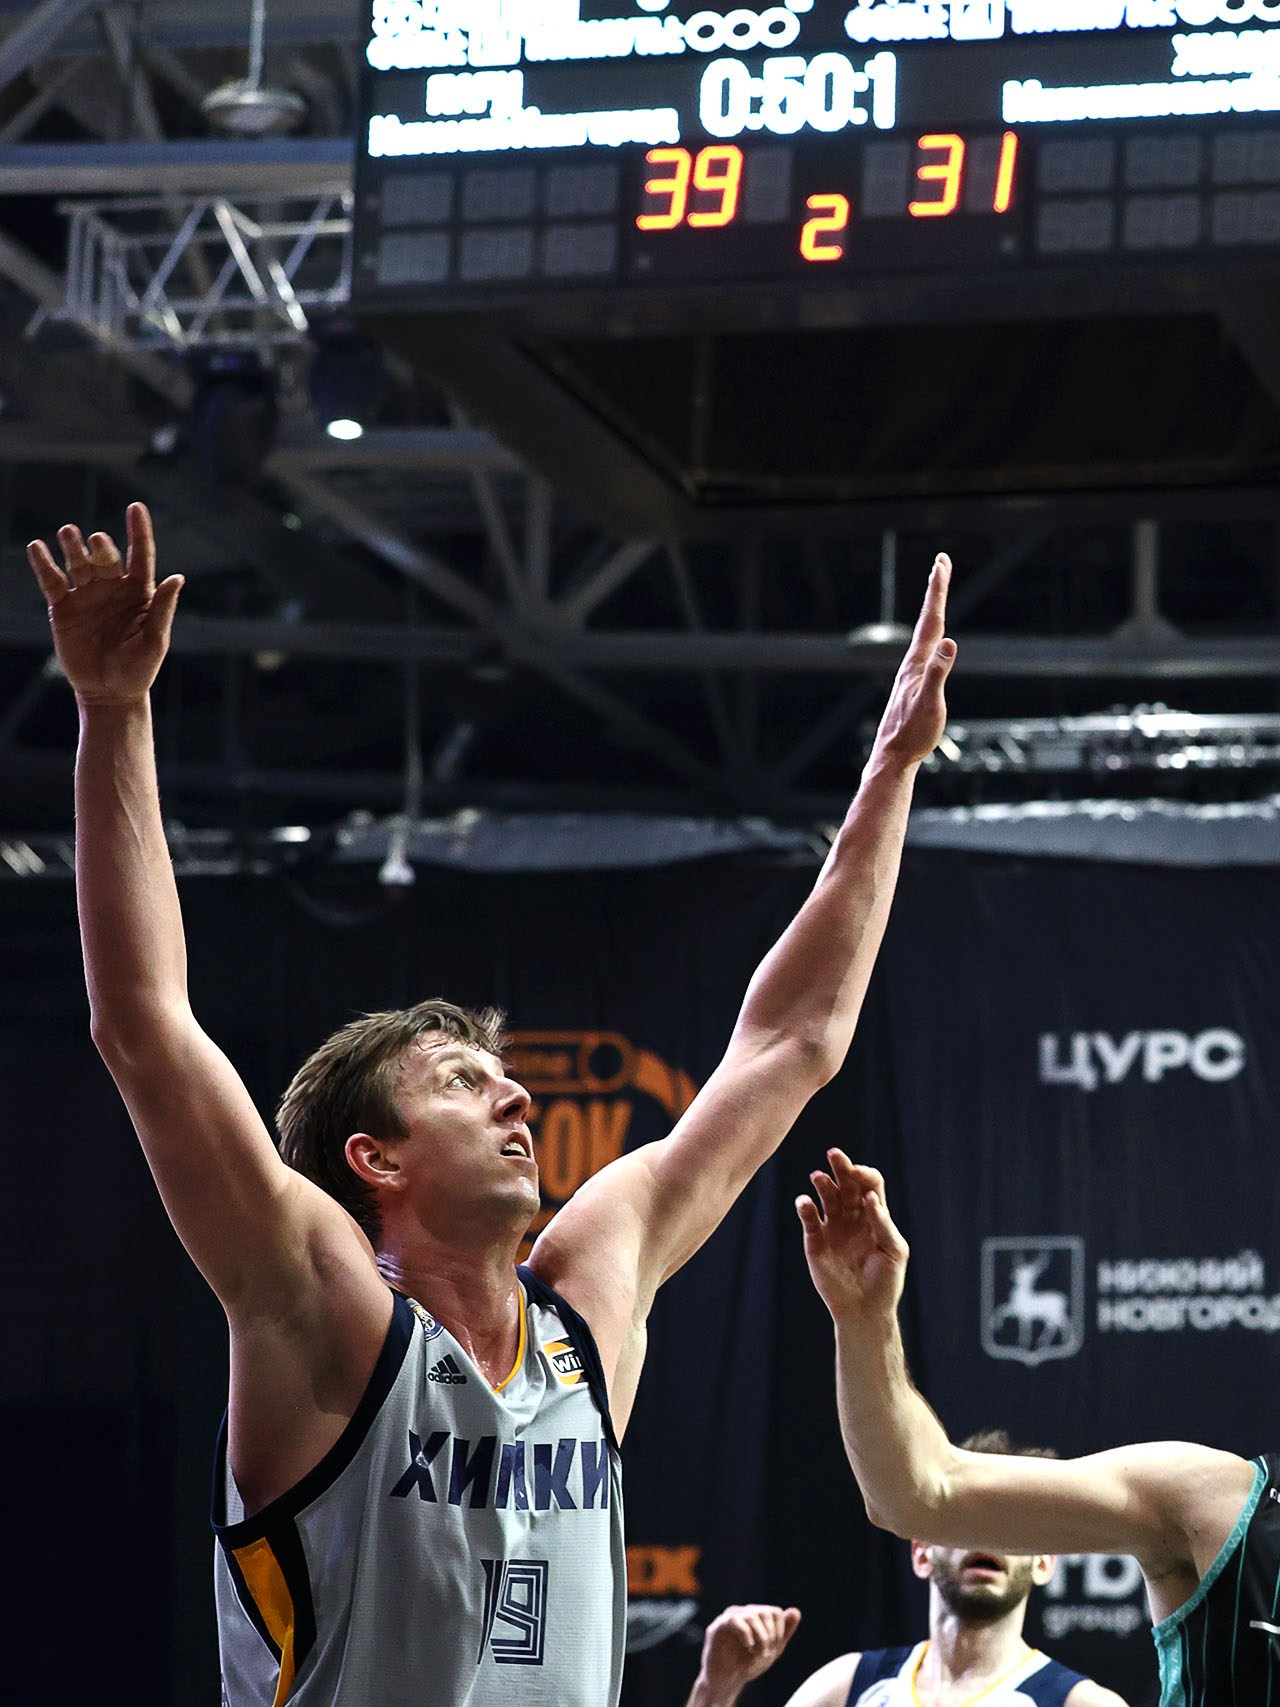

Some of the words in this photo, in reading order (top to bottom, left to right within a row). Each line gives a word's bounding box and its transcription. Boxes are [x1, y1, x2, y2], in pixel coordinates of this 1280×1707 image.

[636, 145, 743, 230] 39
[909, 131, 1018, 217] 31
[800, 194, 849, 261] 2
[1039, 1027, 1246, 1092] ЦУРС
[427, 1371, 467, 1385] adidas
[476, 1558, 550, 1666] 19
